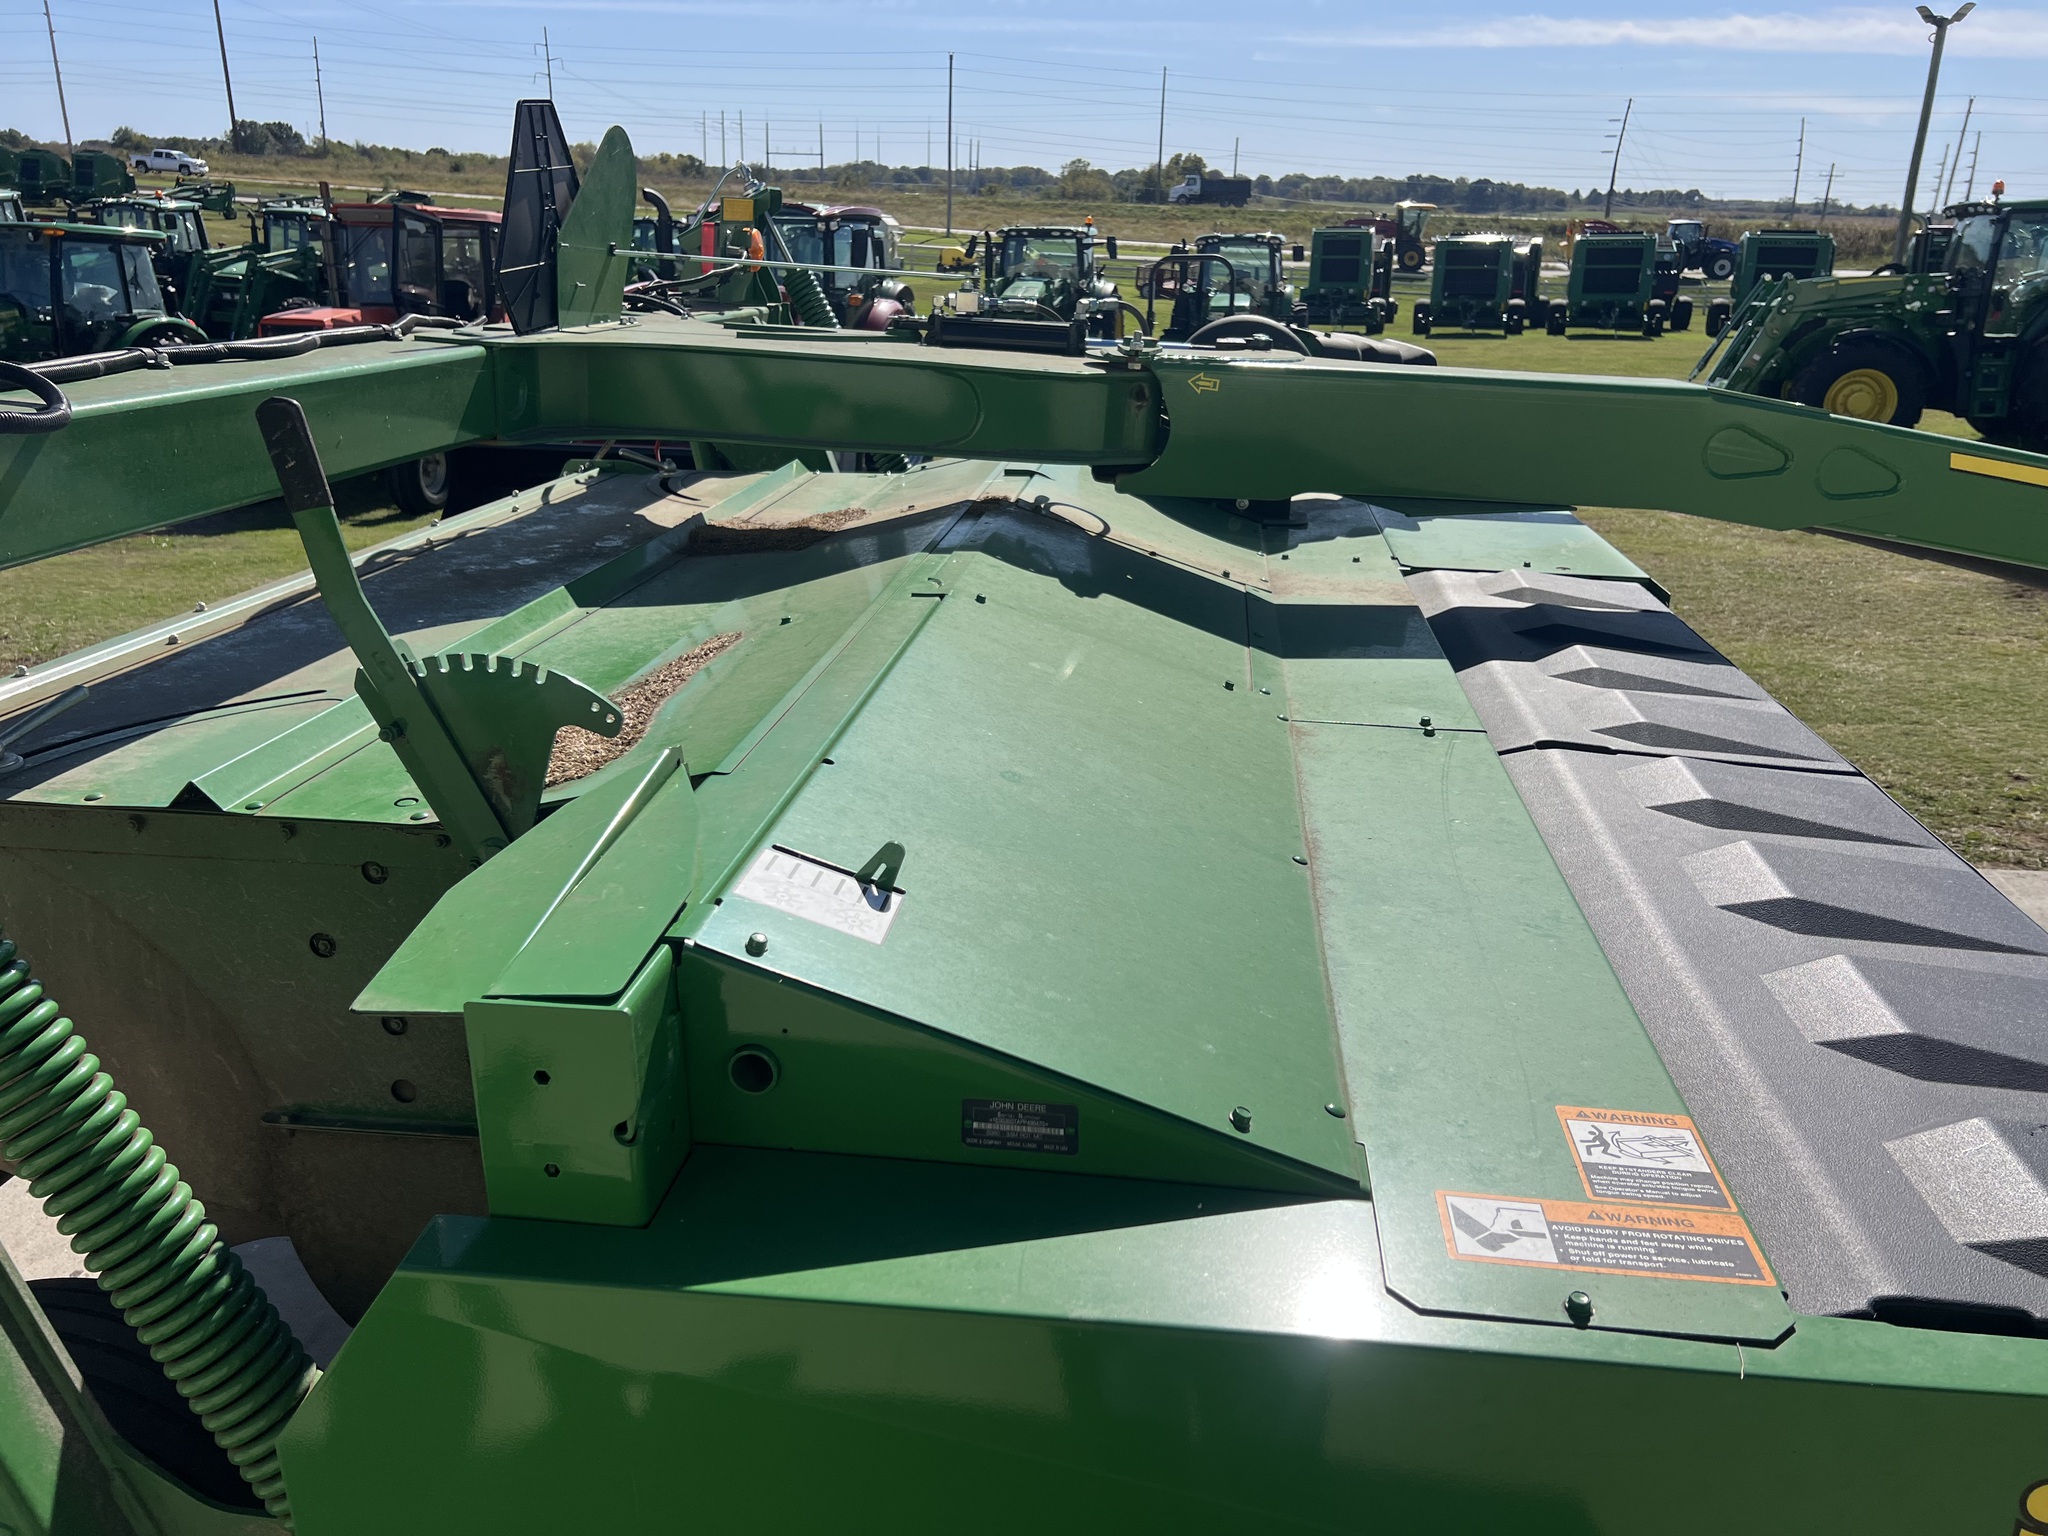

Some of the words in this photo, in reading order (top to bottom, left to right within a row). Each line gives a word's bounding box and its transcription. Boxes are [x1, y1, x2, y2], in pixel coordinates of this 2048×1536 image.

[989, 1101, 1014, 1110] JOHN
[1017, 1103, 1047, 1113] DEERE
[1591, 1111, 1678, 1126] WARNING
[1604, 1212, 1695, 1228] WARNING
[1552, 1224, 1581, 1233] AVOID
[1584, 1227, 1619, 1236] INJURY
[1621, 1230, 1651, 1239] FROM
[1652, 1232, 1704, 1243] ROTATING
[1706, 1237, 1744, 1246] KNIVES
[1563, 1233, 1587, 1242] Keep
[1589, 1235, 1619, 1244] hands
[1620, 1238, 1639, 1246] and
[1640, 1239, 1659, 1247] feet
[1687, 1243, 1713, 1252] while
[1565, 1241, 1604, 1249] machine
[1617, 1245, 1658, 1254] running.
[1568, 1248, 1590, 1256] Shut
[1608, 1252, 1637, 1260] power
[1639, 1253, 1649, 1261] to
[1651, 1256, 1691, 1265] service,
[1691, 1258, 1735, 1268] lubricate
[1581, 1255, 1601, 1263] fold
[1619, 1259, 1667, 1269] transport.
